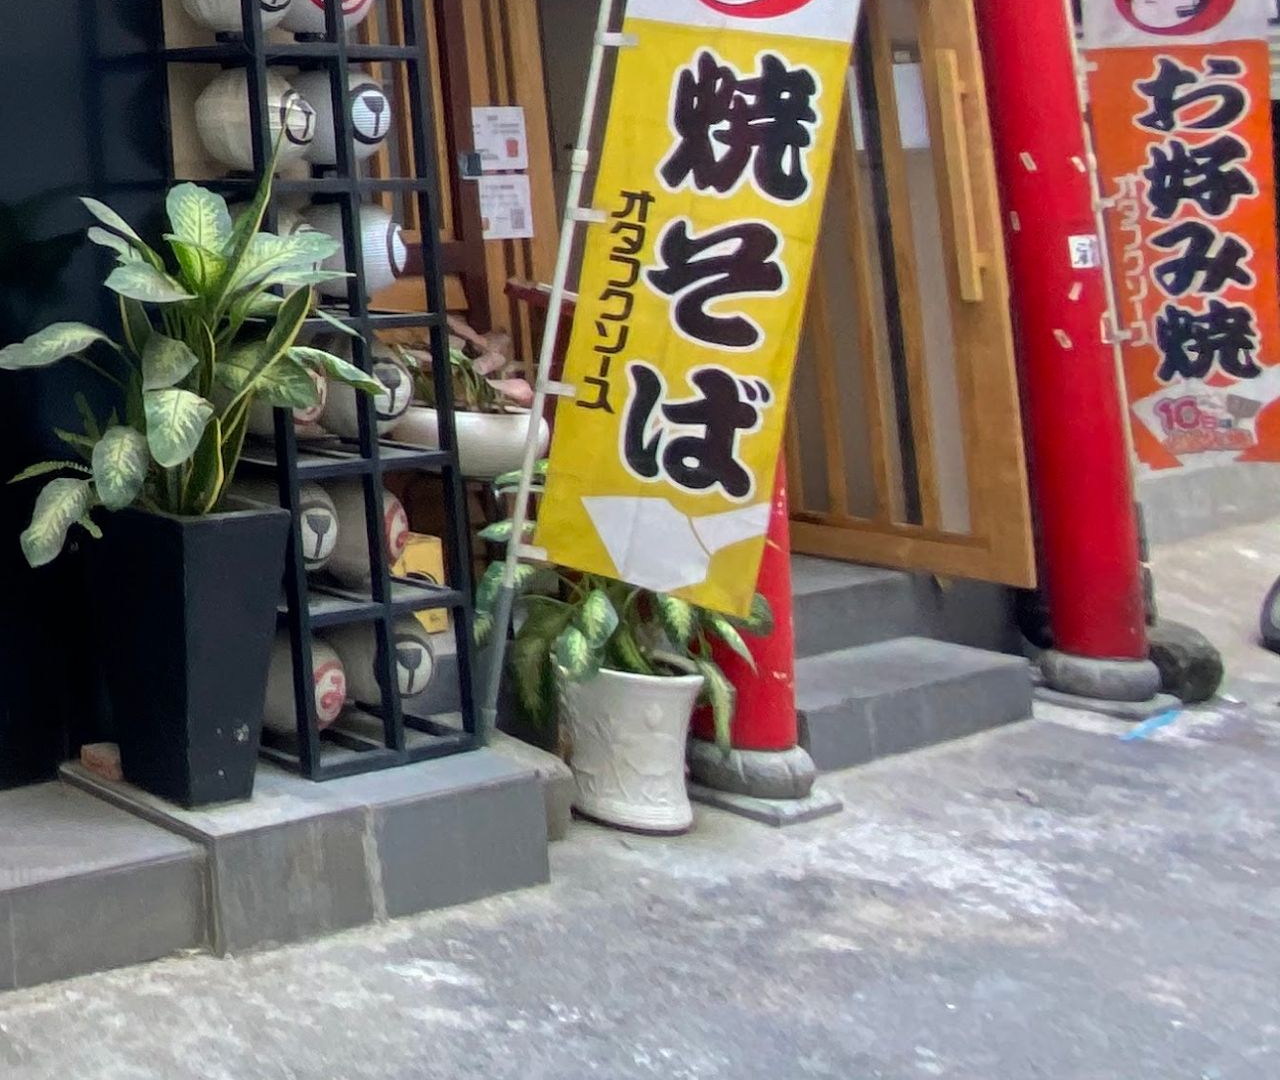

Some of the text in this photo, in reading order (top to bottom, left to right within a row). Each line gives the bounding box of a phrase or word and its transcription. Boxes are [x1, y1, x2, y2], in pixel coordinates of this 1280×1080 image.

[576, 190, 656, 414] オタフクソース
[622, 51, 820, 500] 焼そば
[1135, 57, 1263, 382] お好み焼
